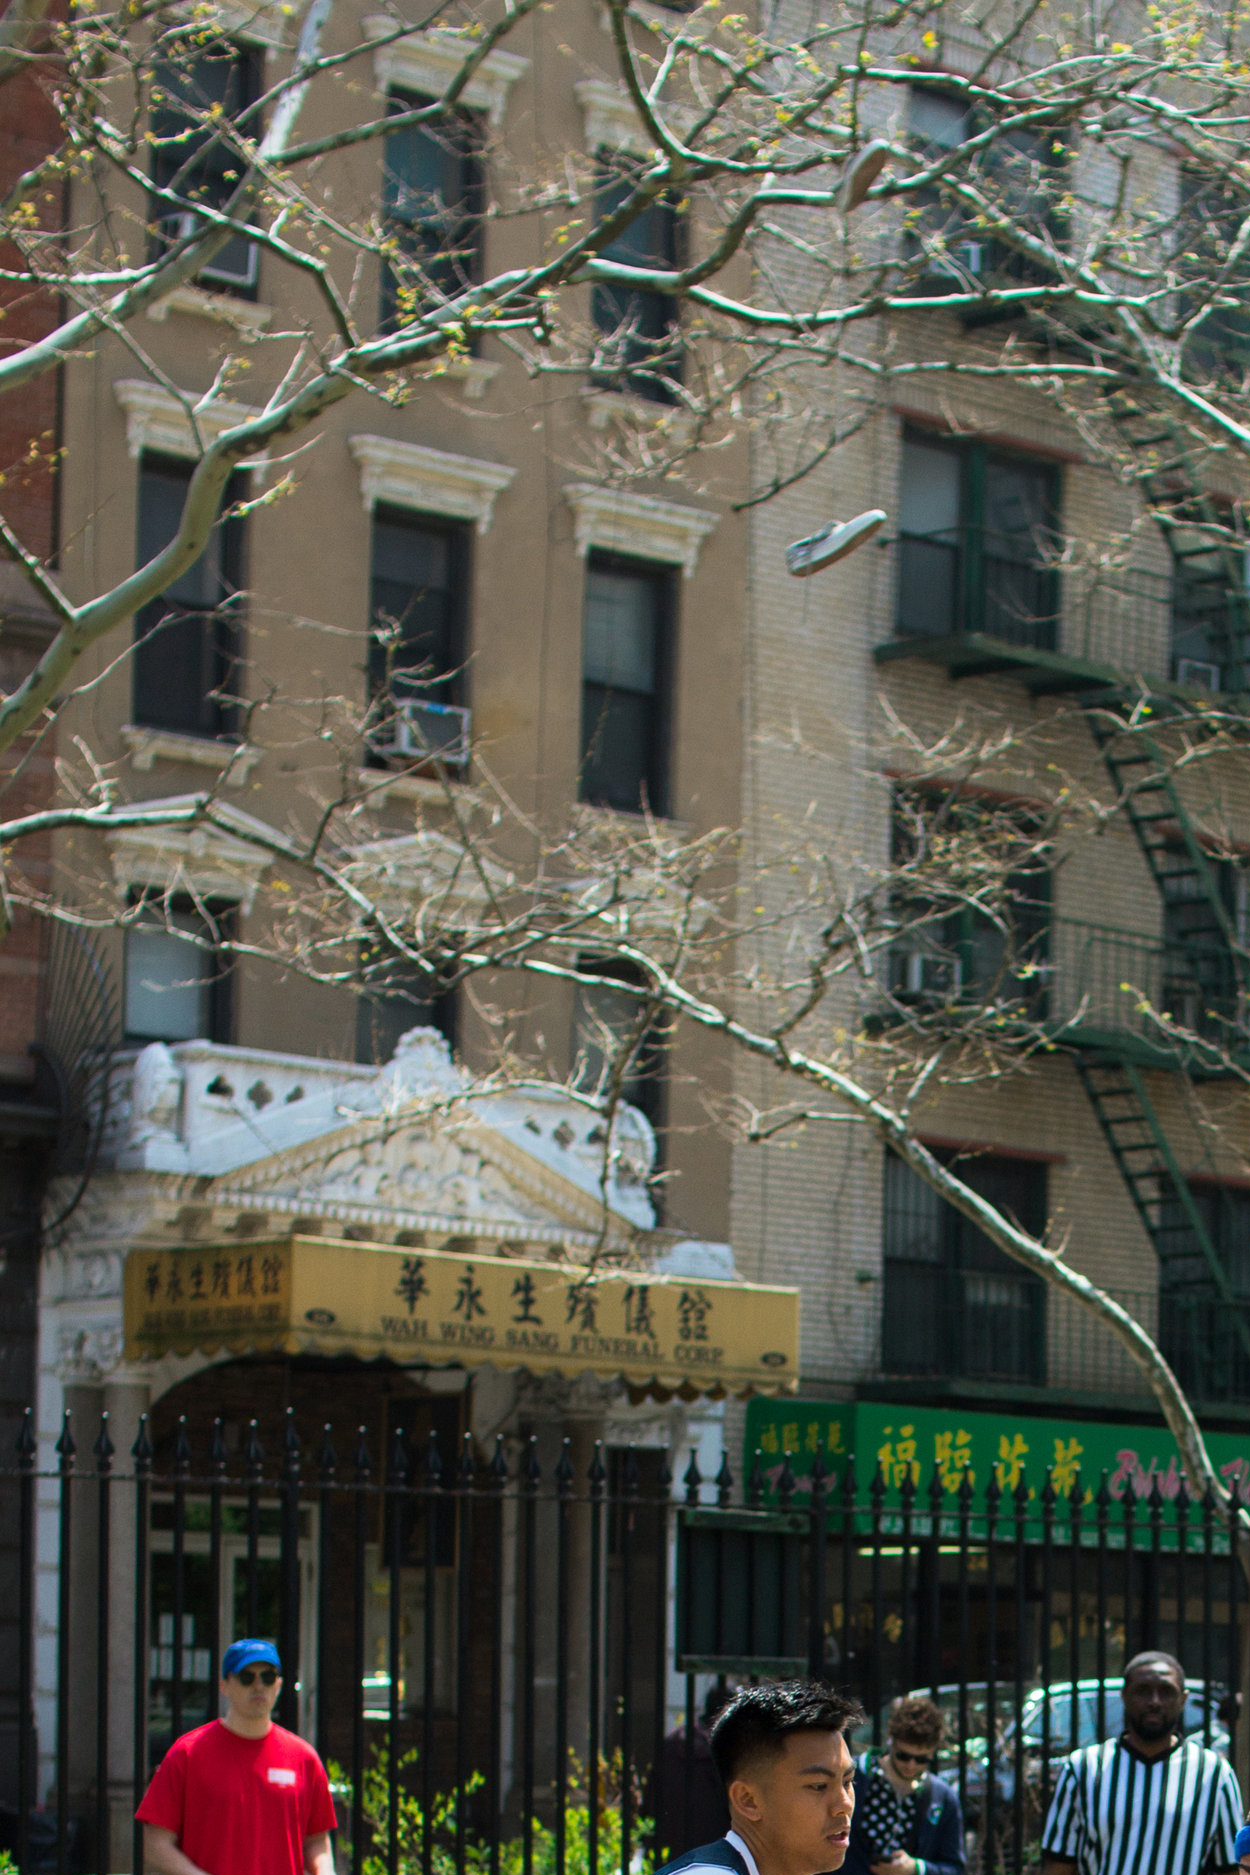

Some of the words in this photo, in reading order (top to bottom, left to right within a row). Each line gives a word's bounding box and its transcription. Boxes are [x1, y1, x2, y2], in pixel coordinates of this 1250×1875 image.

[381, 1315, 428, 1338] WAH
[440, 1321, 495, 1344] WING
[506, 1328, 560, 1351] SANG
[571, 1335, 664, 1361] FUNERAL
[673, 1343, 724, 1364] CORP
